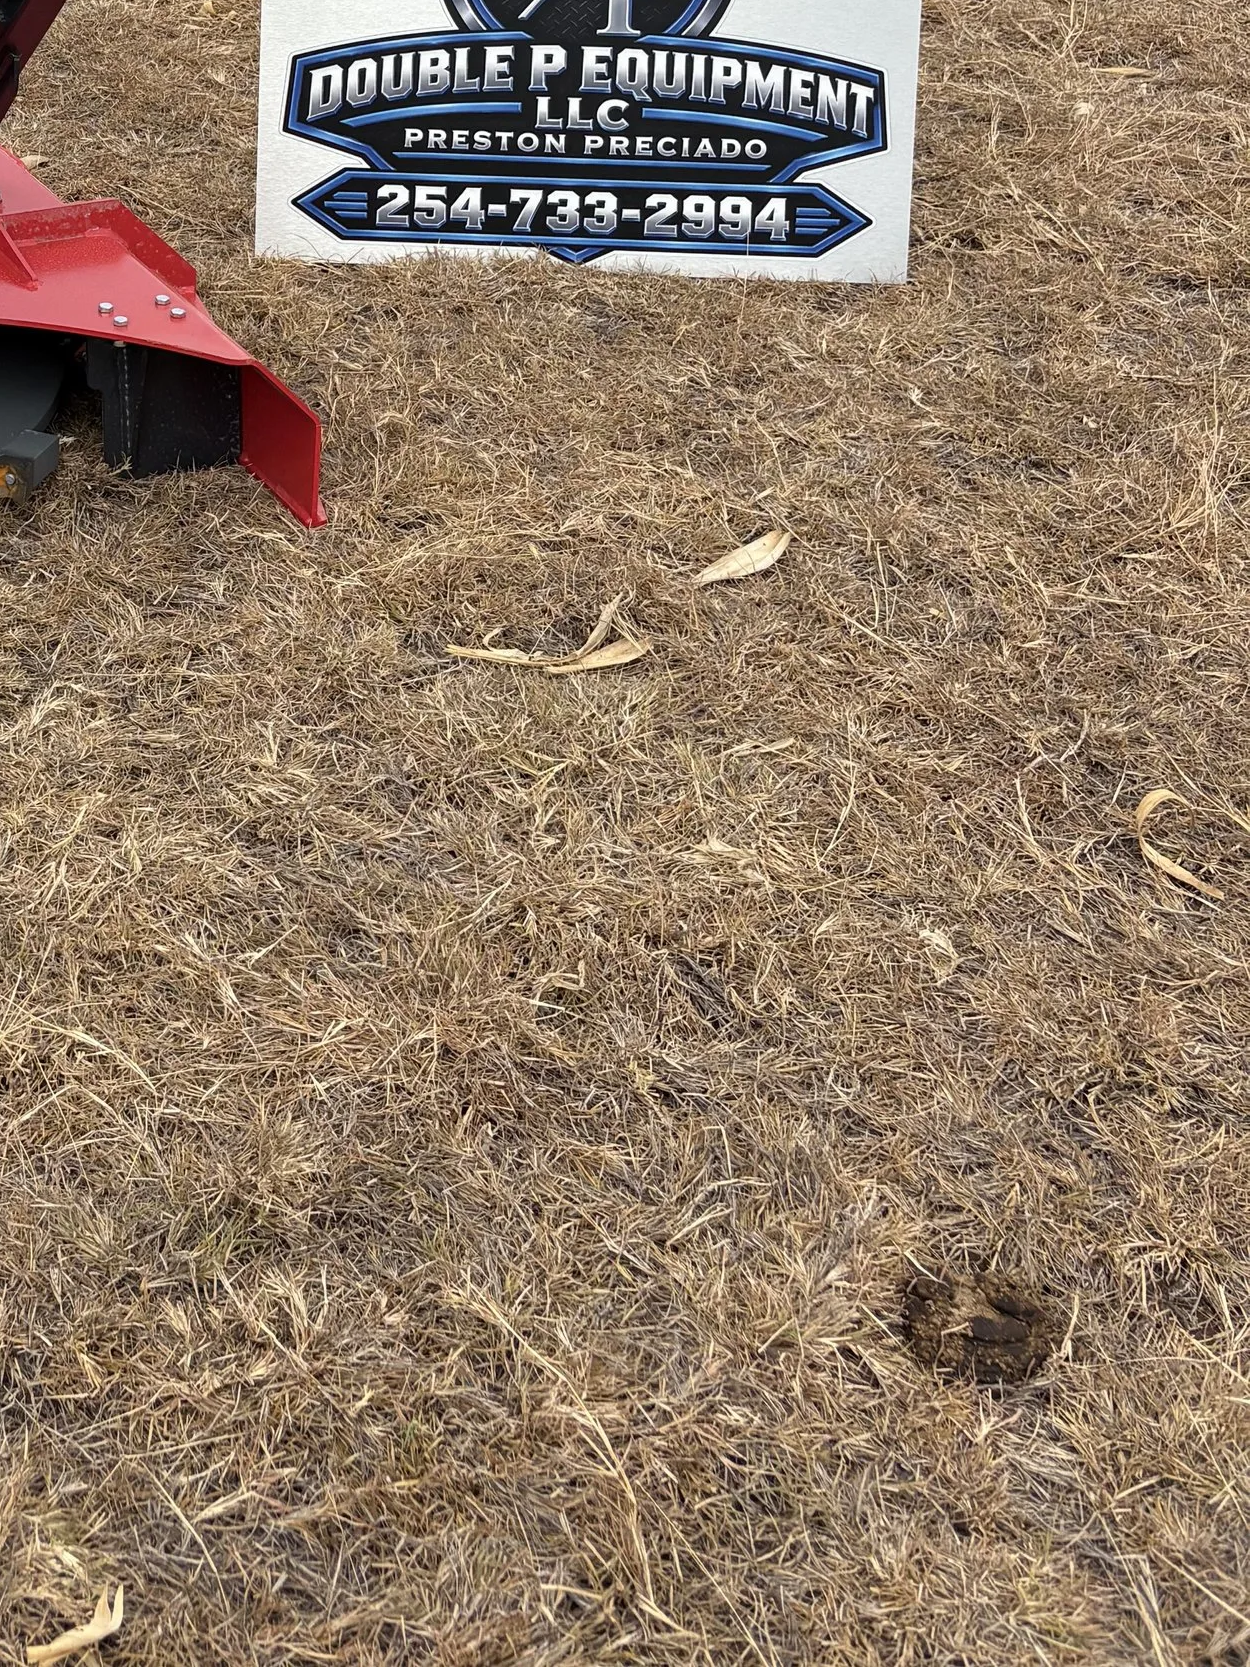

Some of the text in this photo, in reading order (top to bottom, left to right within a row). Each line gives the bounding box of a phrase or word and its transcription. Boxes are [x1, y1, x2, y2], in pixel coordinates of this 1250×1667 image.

[306, 44, 875, 138] DOUBLE P EQUIPMENT
[534, 96, 630, 132] LLC
[404, 128, 768, 159] PRESTON PRECIADO
[376, 184, 789, 241] 254-733-2994
